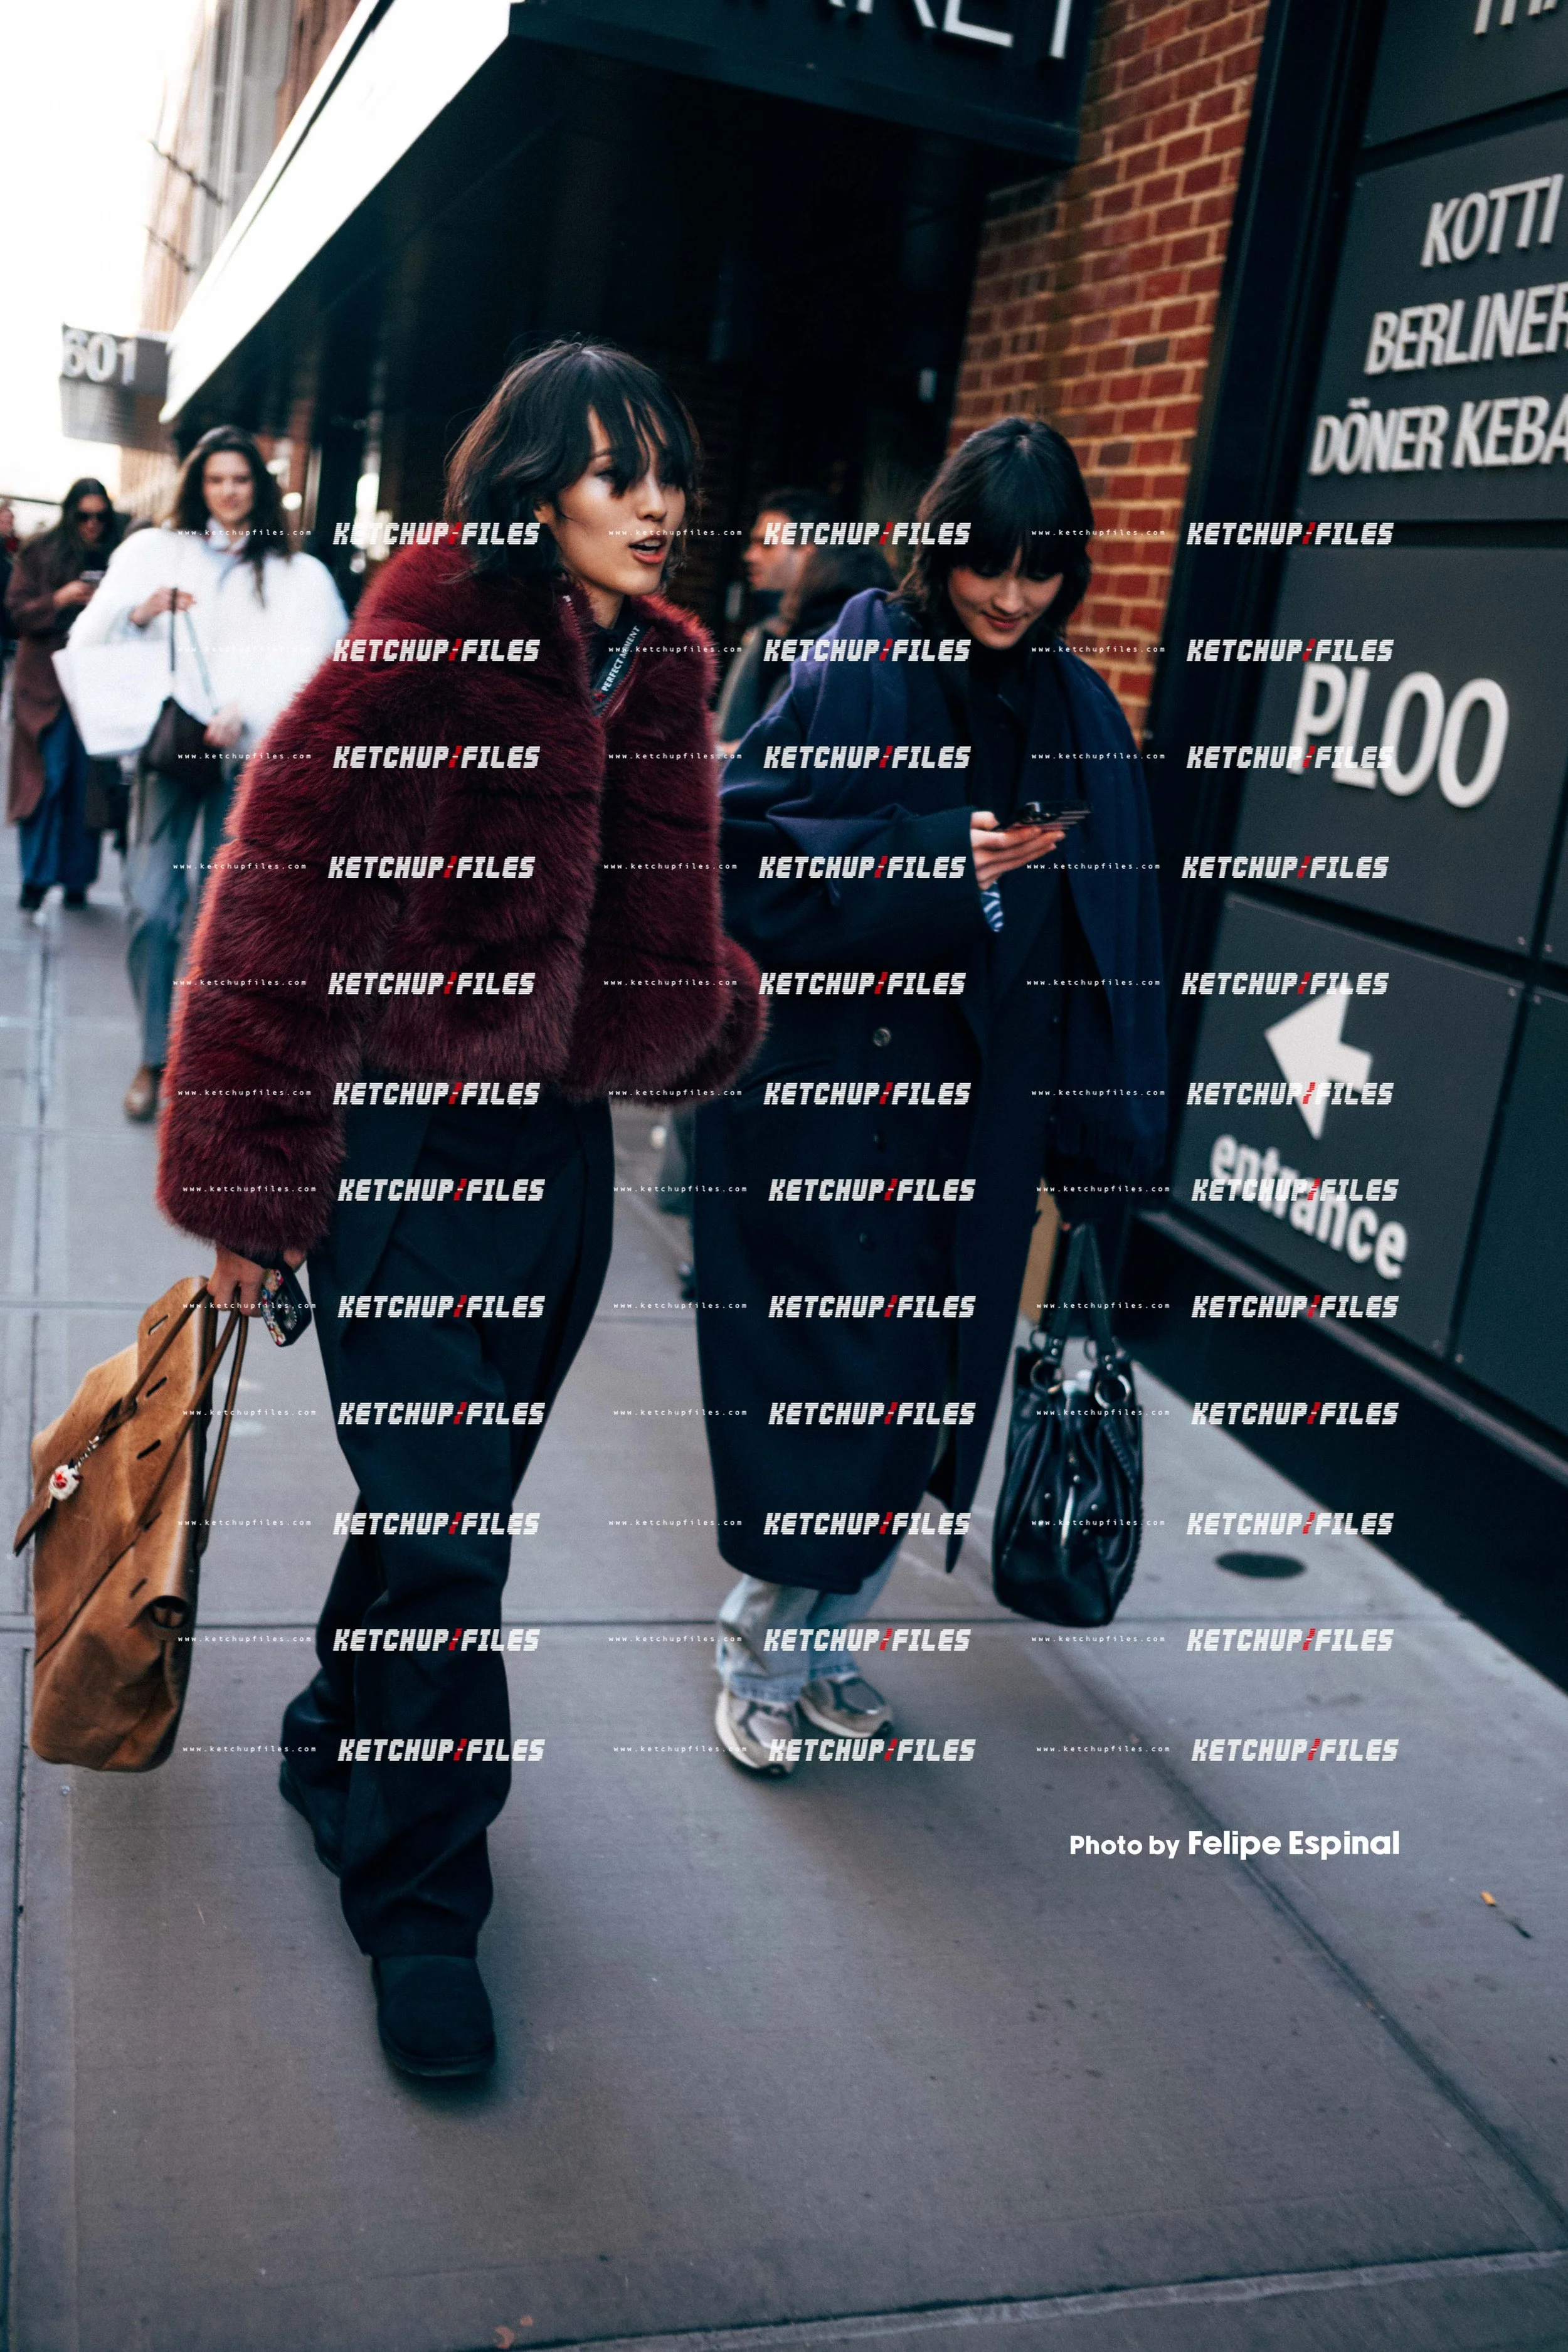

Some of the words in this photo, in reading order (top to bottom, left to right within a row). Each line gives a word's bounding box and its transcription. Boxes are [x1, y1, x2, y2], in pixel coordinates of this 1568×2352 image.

[1421, 174, 1564, 268] KOTTI
[62, 328, 137, 385] 601
[1308, 396, 1449, 475] DÖNER
[601, 657, 624, 691] PERFECT
[1210, 1135, 1407, 1280] entrance
